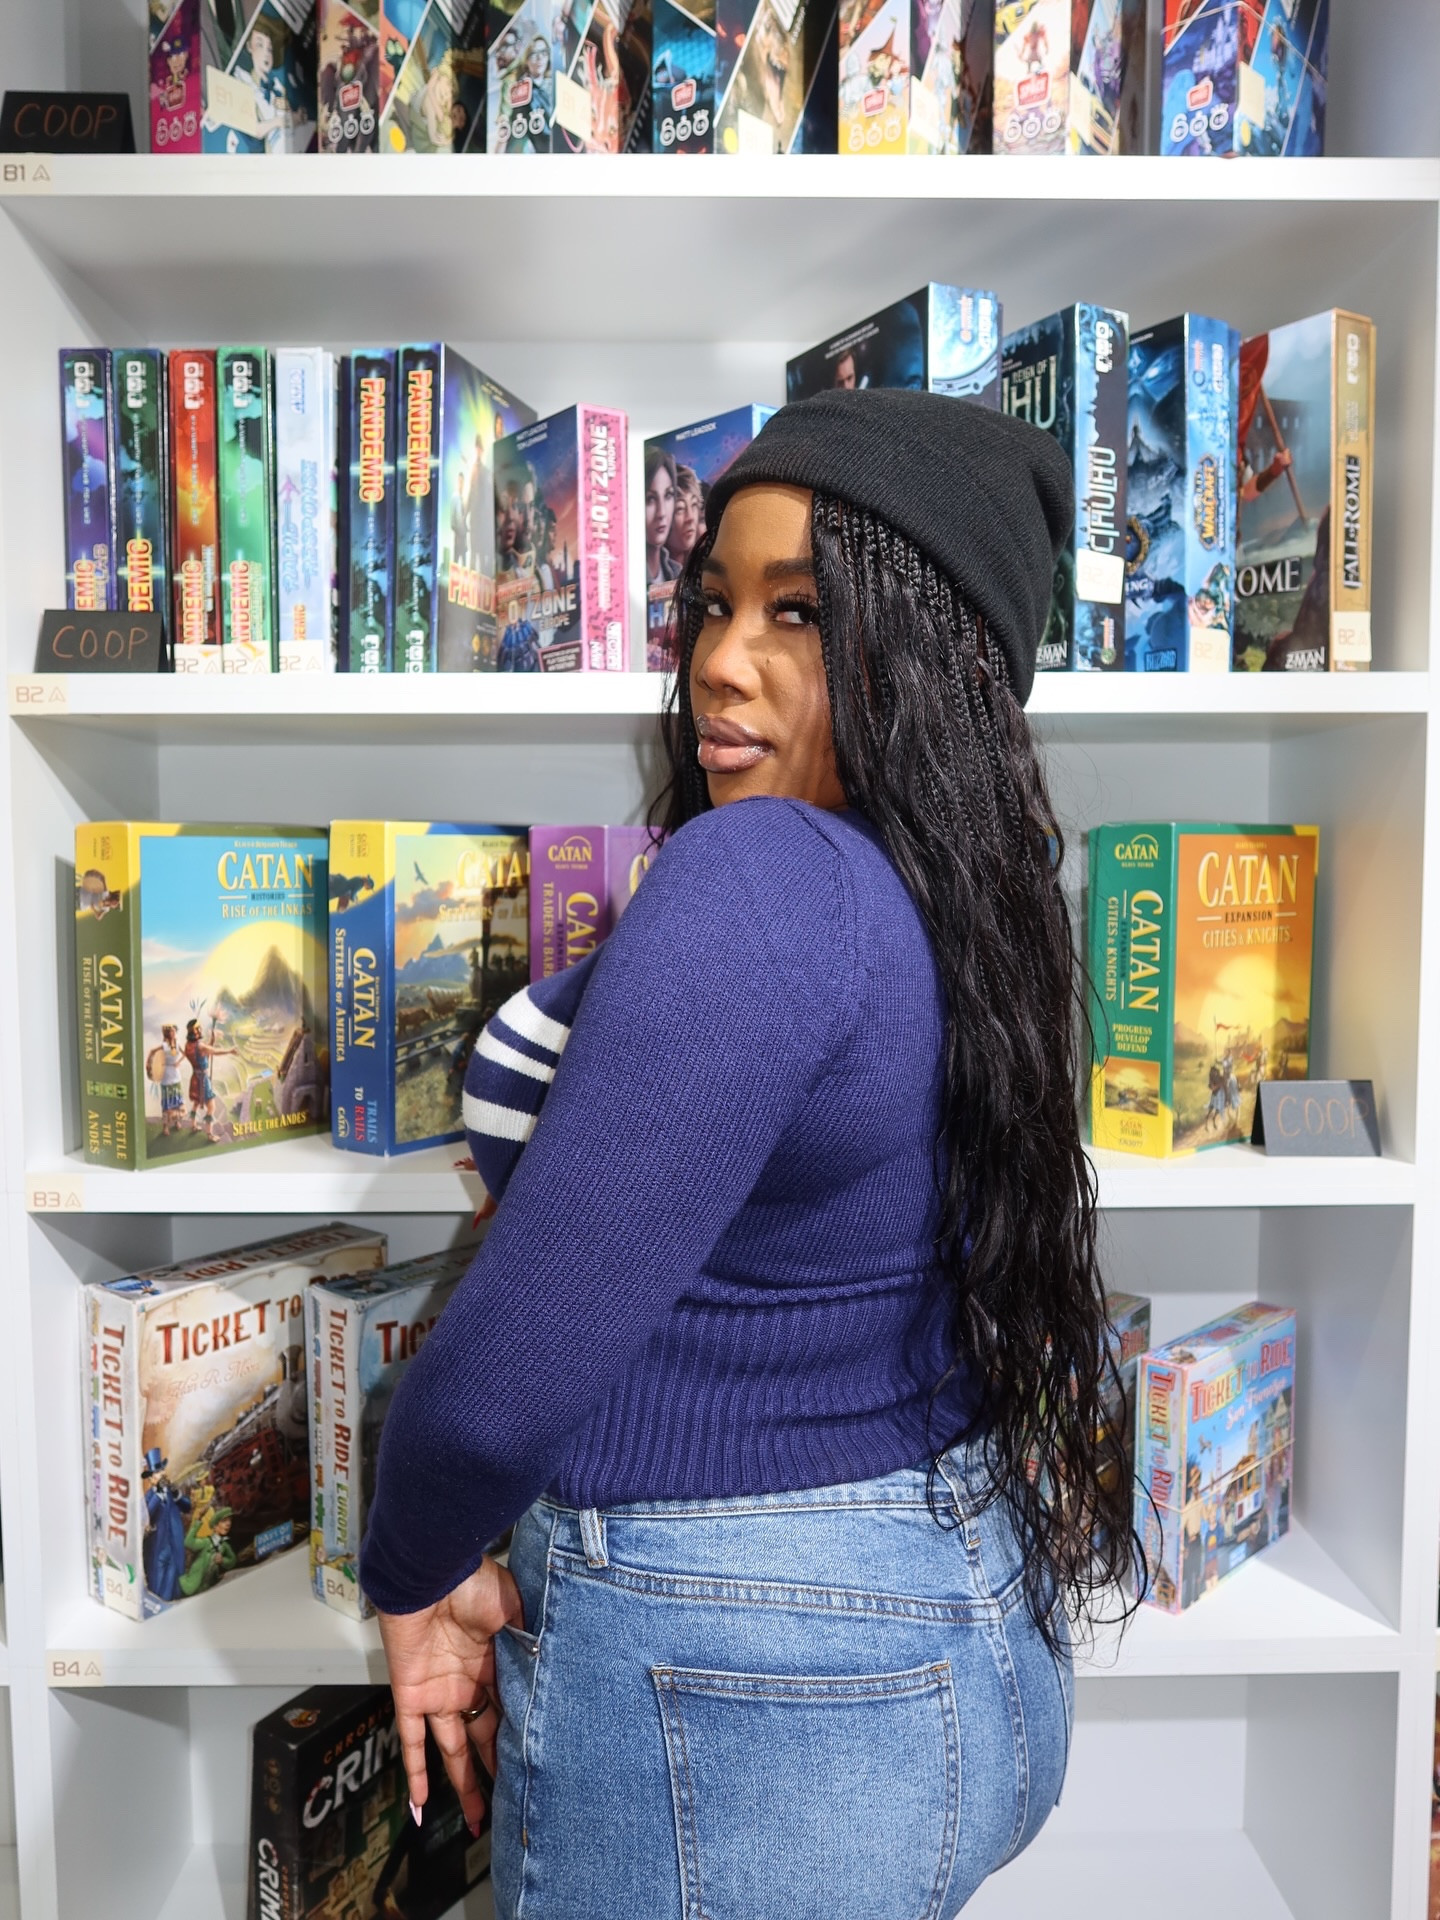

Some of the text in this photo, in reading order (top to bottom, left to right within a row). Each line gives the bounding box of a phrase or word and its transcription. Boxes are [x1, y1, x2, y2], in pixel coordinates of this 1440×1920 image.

[14, 102, 118, 138] COOP
[3, 164, 26, 182] B1
[1011, 364, 1036, 384] REIGN
[1036, 359, 1049, 376] OF
[359, 377, 386, 503] PANDEMIC
[406, 369, 433, 498] PANDEMIC
[590, 424, 609, 484] ZONE
[591, 489, 609, 540] HOT
[1086, 446, 1120, 553] CTHULHU
[1200, 463, 1217, 539] WARCRAFT
[1343, 455, 1361, 526] ROME
[300, 460, 318, 577] RESPONSE
[126, 538, 153, 612] DEMIC
[282, 523, 299, 593] RAPID
[1235, 556, 1301, 600] OME
[1343, 537, 1363, 590] FALL
[74, 560, 96, 610] EMIC
[448, 560, 497, 618] PAND
[530, 583, 577, 620] ZONE
[52, 625, 149, 660] COOP
[175, 658, 199, 674] B2
[223, 659, 247, 674] B2
[279, 655, 301, 672] B2
[16, 685, 44, 704] B2
[217, 850, 315, 890] CATAN
[456, 850, 530, 889] CATA
[548, 843, 593, 862] CATAN
[1114, 842, 1159, 861] CATAN
[1197, 851, 1299, 908] CATAN
[222, 901, 313, 919] RISE OF THE INKAS
[543, 881, 554, 936] TRADERS
[566, 892, 599, 968] CAT
[1107, 896, 1119, 936] CITIES
[1224, 910, 1273, 924] EXPANSION
[334, 927, 346, 989] SETTLERS
[1128, 890, 1164, 1013] CATAN
[1203, 929, 1237, 949] CITIES
[1247, 926, 1291, 945] KNIGHTS
[353, 946, 378, 1050] CATAN
[1105, 947, 1118, 1001] KNIGHTS
[81, 957, 94, 1061] RISE OF THE INKAS
[99, 953, 125, 1067] CATAN
[1112, 1023, 1153, 1036] PROGRESS
[335, 1007, 346, 1063] AMERICA
[1115, 1032, 1150, 1045] DEVELOP
[1117, 1042, 1148, 1054] DEFEND
[87, 1109, 100, 1155] ANDES
[102, 1123, 112, 1146] THE
[115, 1110, 129, 1160] SETTLE
[232, 1111, 308, 1137] SETTLE THE ANDES
[337, 1106, 349, 1138] CATAN
[354, 1086, 364, 1142] TO RAILS
[367, 1100, 378, 1144] TRAILS
[1278, 1094, 1370, 1138] COOP
[33, 1191, 61, 1208] B3
[155, 1294, 303, 1366] TICKET TO
[376, 1316, 439, 1365] TIC
[1190, 1366, 1247, 1424] TICKET
[1259, 1336, 1293, 1378] RIDE
[329, 1308, 352, 1548] TICKET TO RIDE EUROPE
[1149, 1371, 1176, 1443] TICKET
[101, 1324, 130, 1548] TICKET TO RIDE
[1151, 1466, 1175, 1520] RIDE
[106, 1579, 124, 1597] B4
[326, 1578, 345, 1598] B4
[52, 1661, 81, 1677] B4
[323, 1702, 393, 1765] CHRONIC
[302, 1724, 399, 1830] CRIM
[257, 1837, 282, 1920] CRIM
